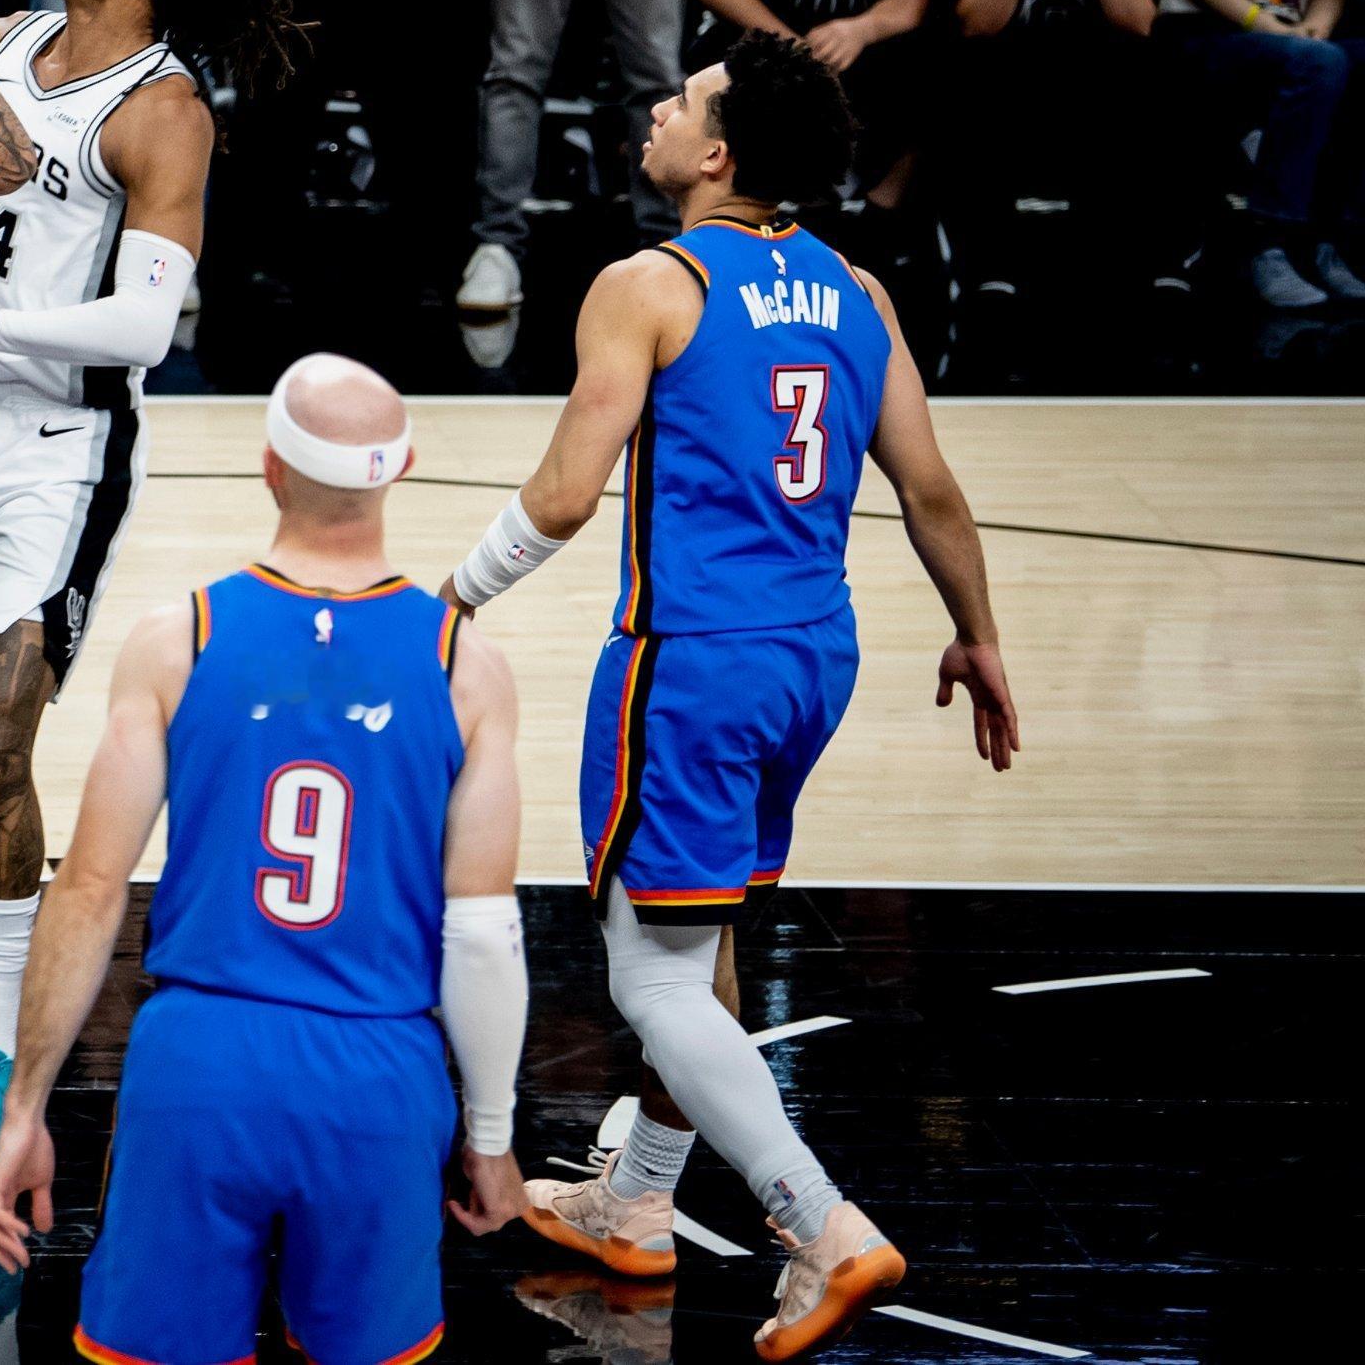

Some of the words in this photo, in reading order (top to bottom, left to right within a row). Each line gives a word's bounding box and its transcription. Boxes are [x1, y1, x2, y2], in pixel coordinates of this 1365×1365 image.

[738, 279, 840, 332] McCAIN
[770, 363, 830, 505] 3
[253, 759, 355, 932] 9
